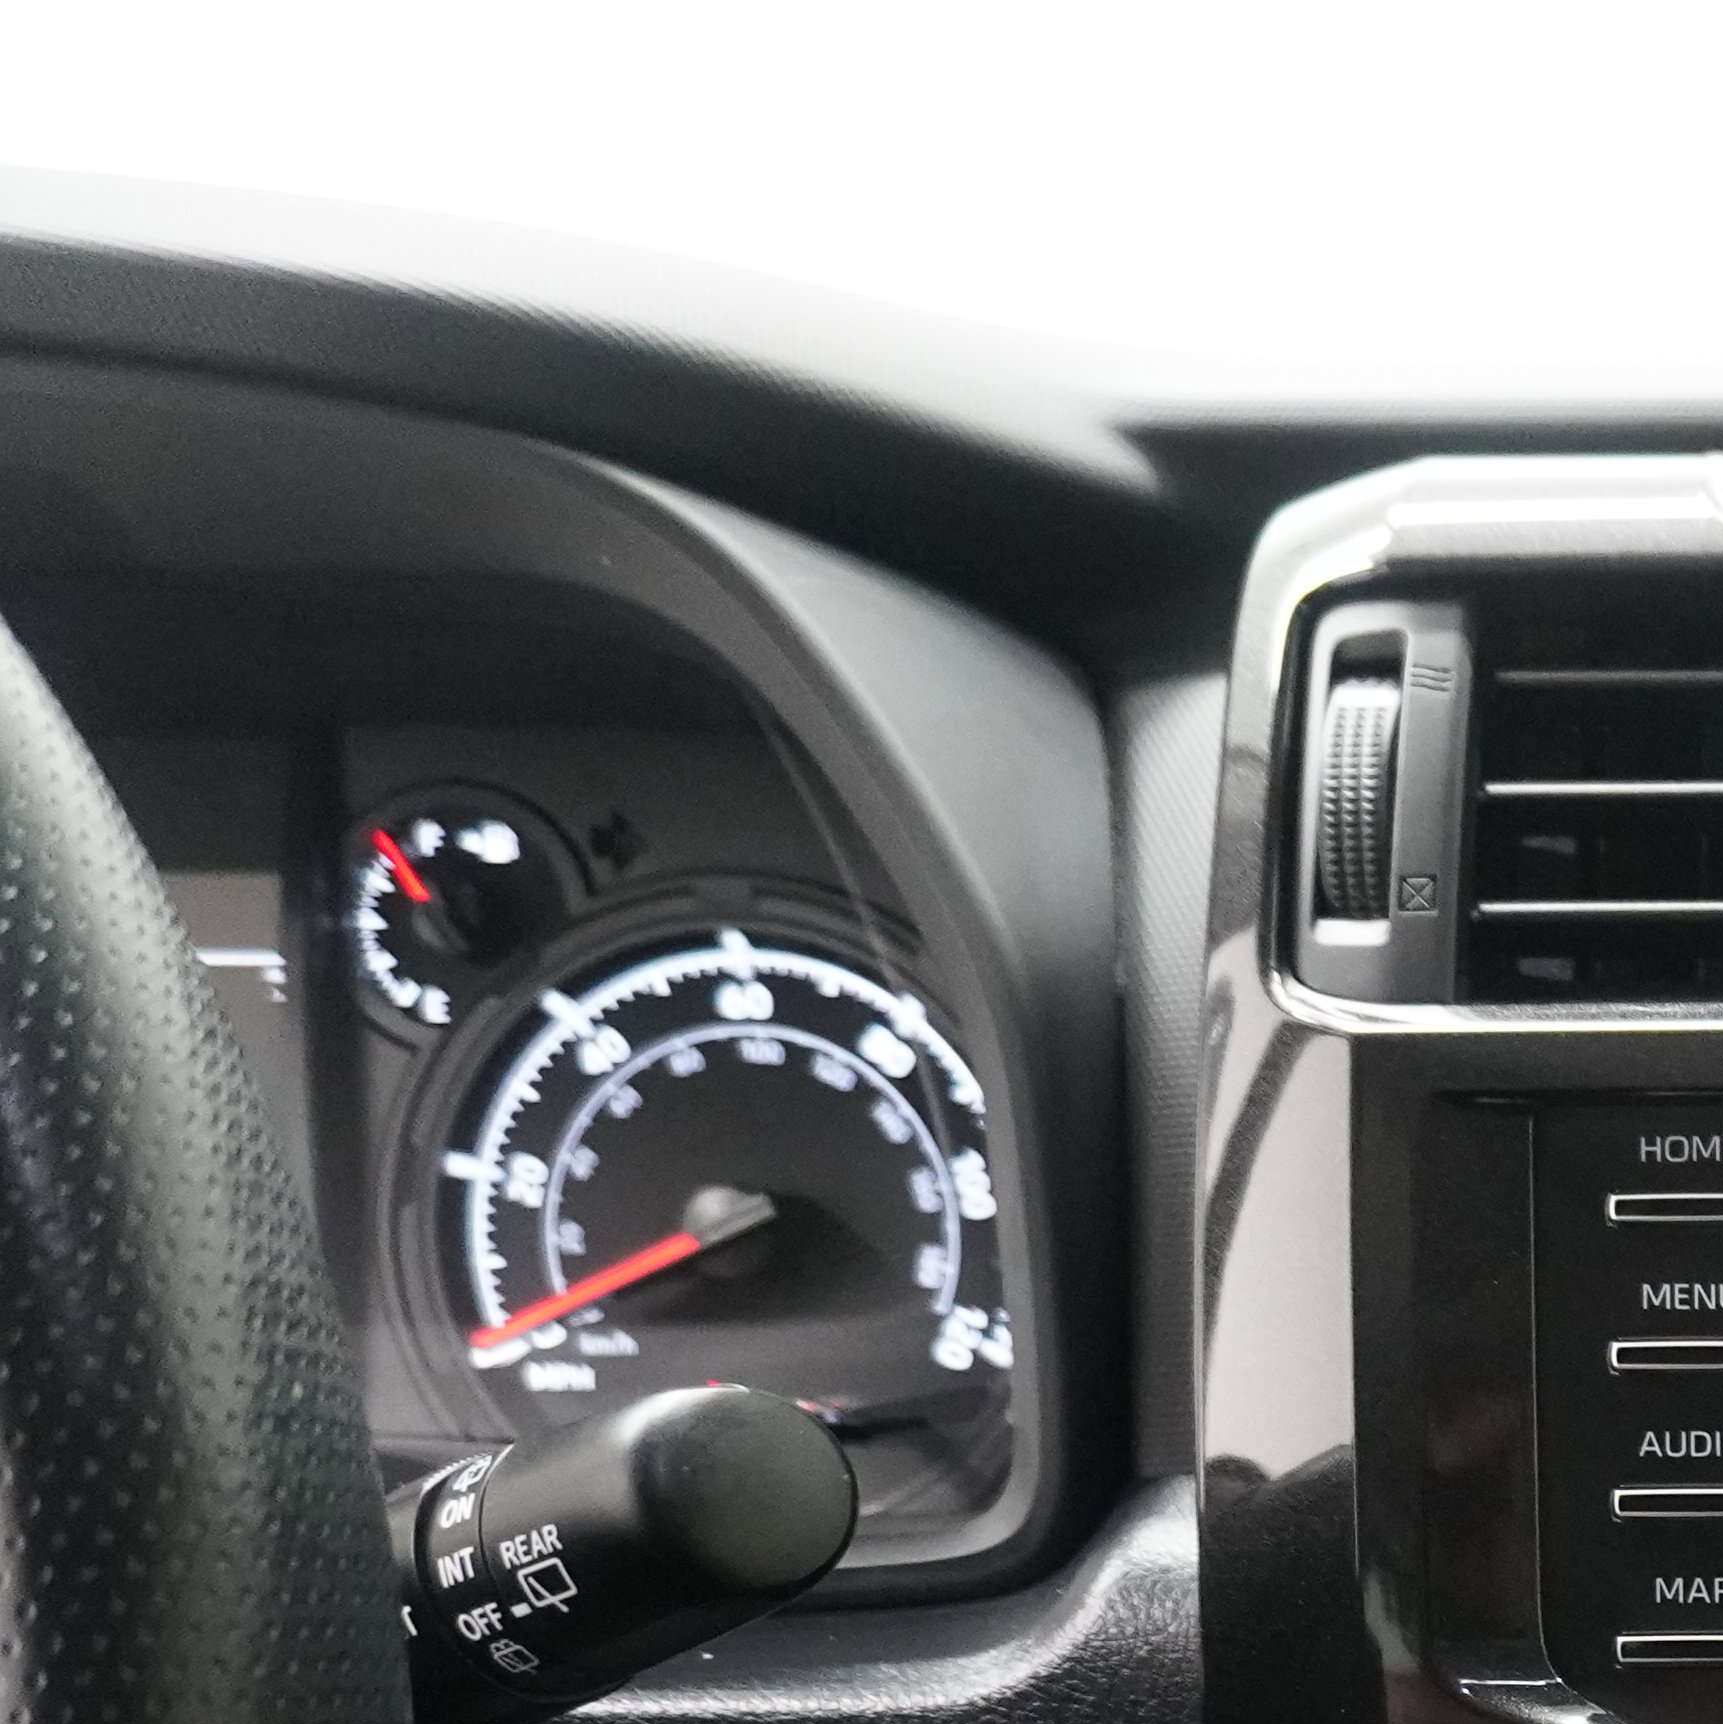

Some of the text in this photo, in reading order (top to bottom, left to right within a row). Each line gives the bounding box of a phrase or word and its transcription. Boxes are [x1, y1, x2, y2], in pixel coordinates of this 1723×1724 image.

[438, 1493, 476, 1529] ON
[500, 1523, 563, 1570] REAR
[437, 1546, 475, 1589] INT
[456, 1601, 504, 1641] OFF
